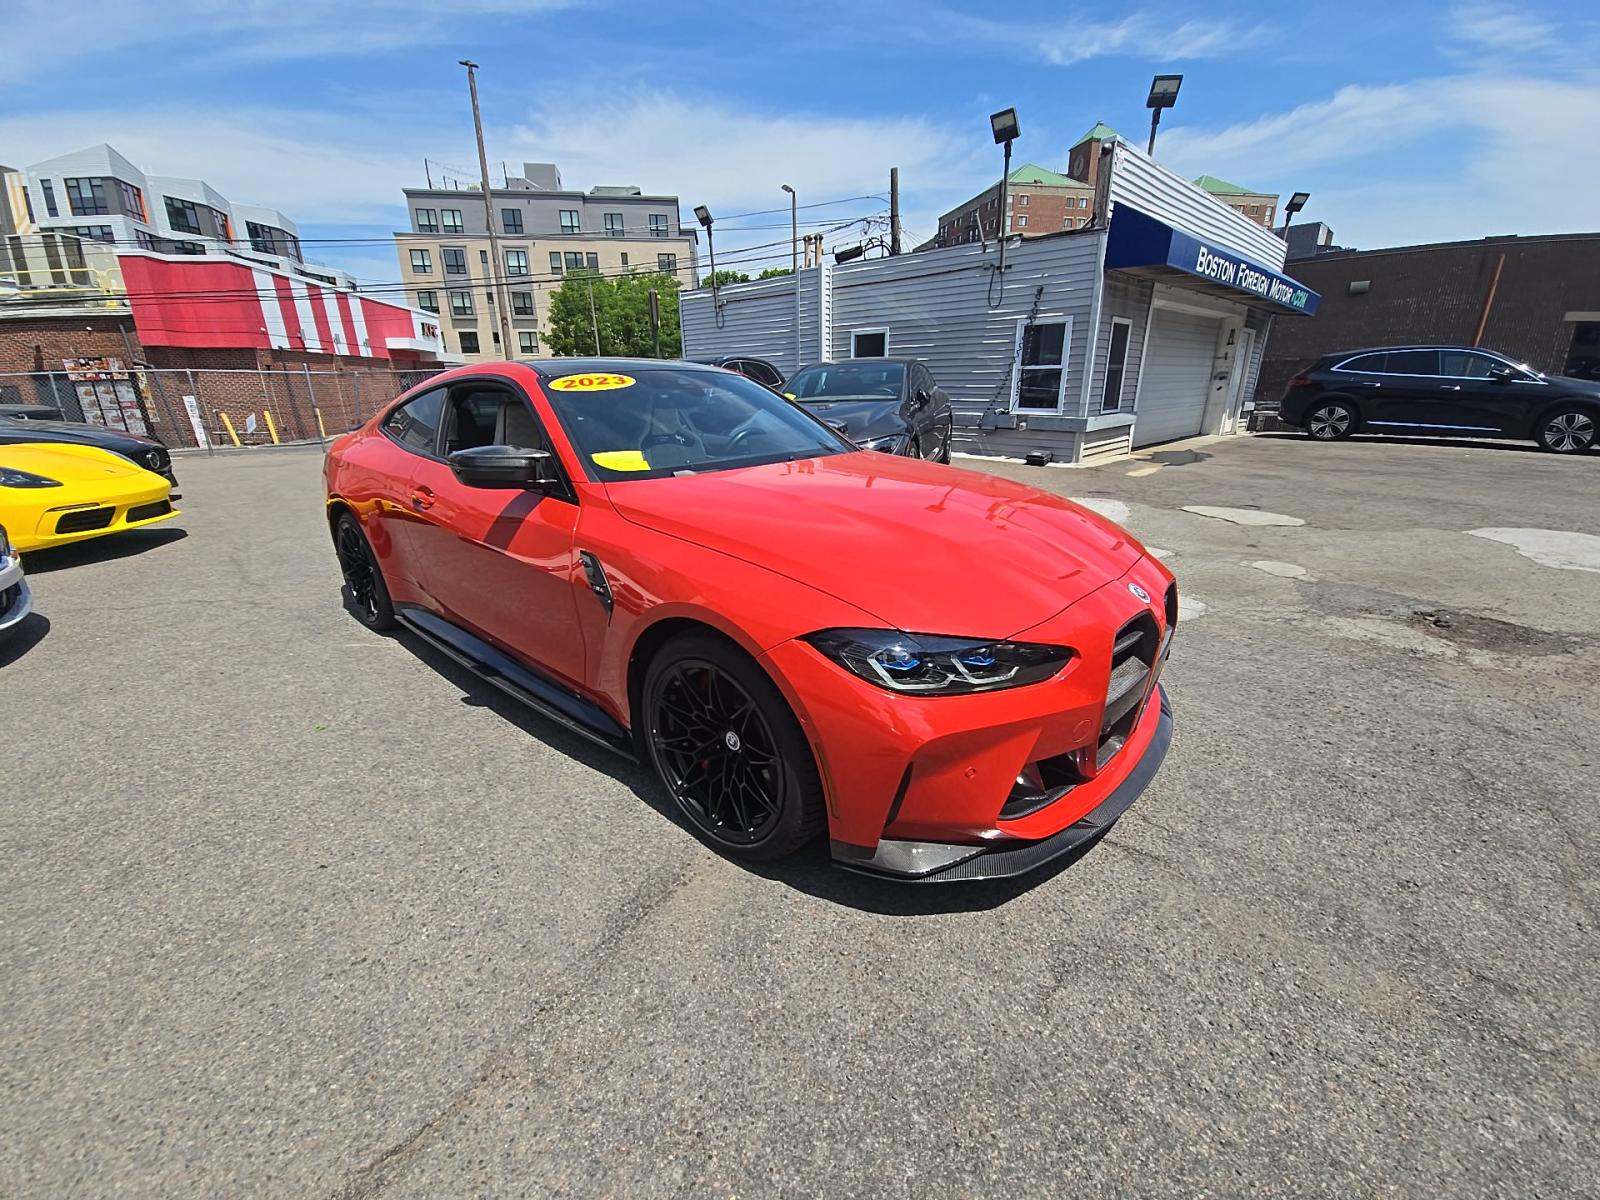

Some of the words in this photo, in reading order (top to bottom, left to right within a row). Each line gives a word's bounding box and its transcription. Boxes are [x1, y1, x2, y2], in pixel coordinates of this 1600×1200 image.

[1196, 246, 1237, 283] BOSTON
[1236, 263, 1270, 296] FOREIGN
[1268, 277, 1294, 303] MOTOR
[562, 376, 627, 389] 2023
